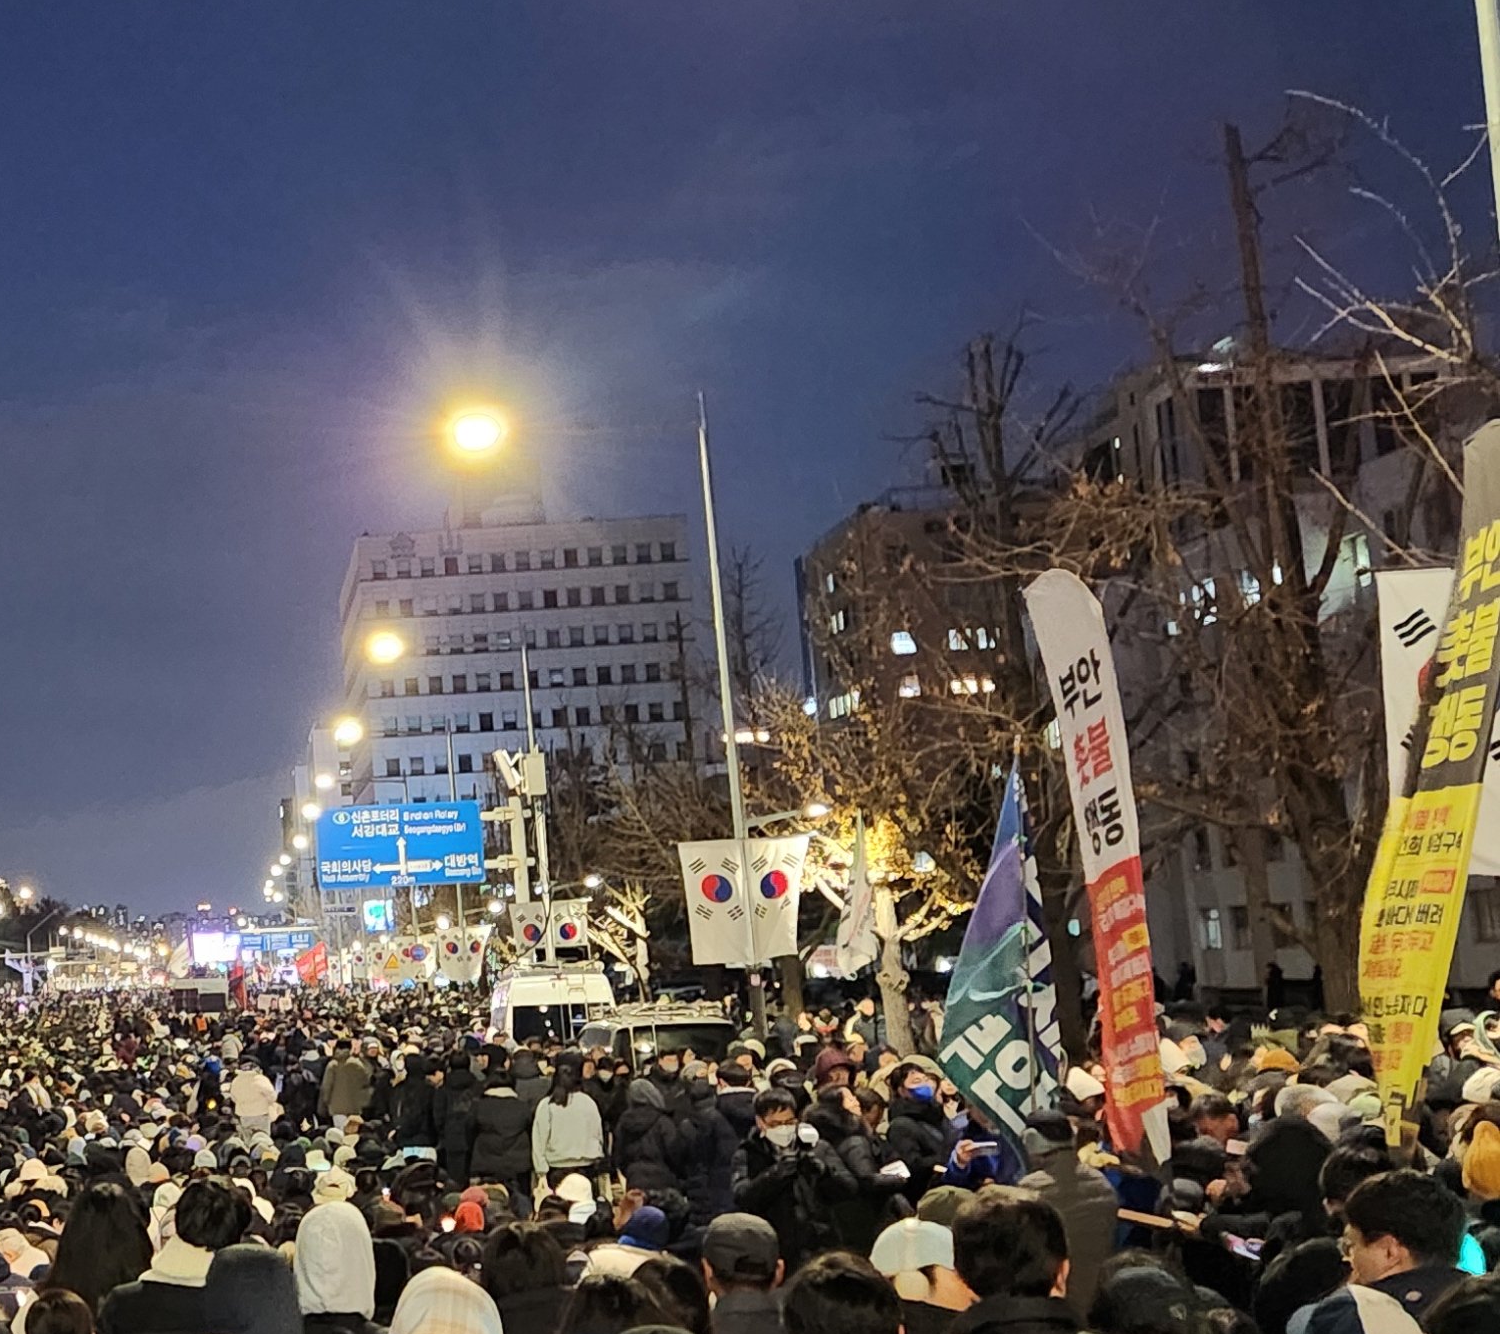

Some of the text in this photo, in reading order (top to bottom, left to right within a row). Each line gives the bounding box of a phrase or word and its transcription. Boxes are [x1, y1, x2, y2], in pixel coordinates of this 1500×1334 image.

[1058, 648, 1102, 719] 부안
[1421, 684, 1487, 769] 행동
[1073, 716, 1113, 791] 촛불
[351, 823, 400, 838] 서강대교
[320, 859, 372, 875] 국회의사당
[444, 853, 479, 868] 대방역
[391, 875, 416, 885] 220m
